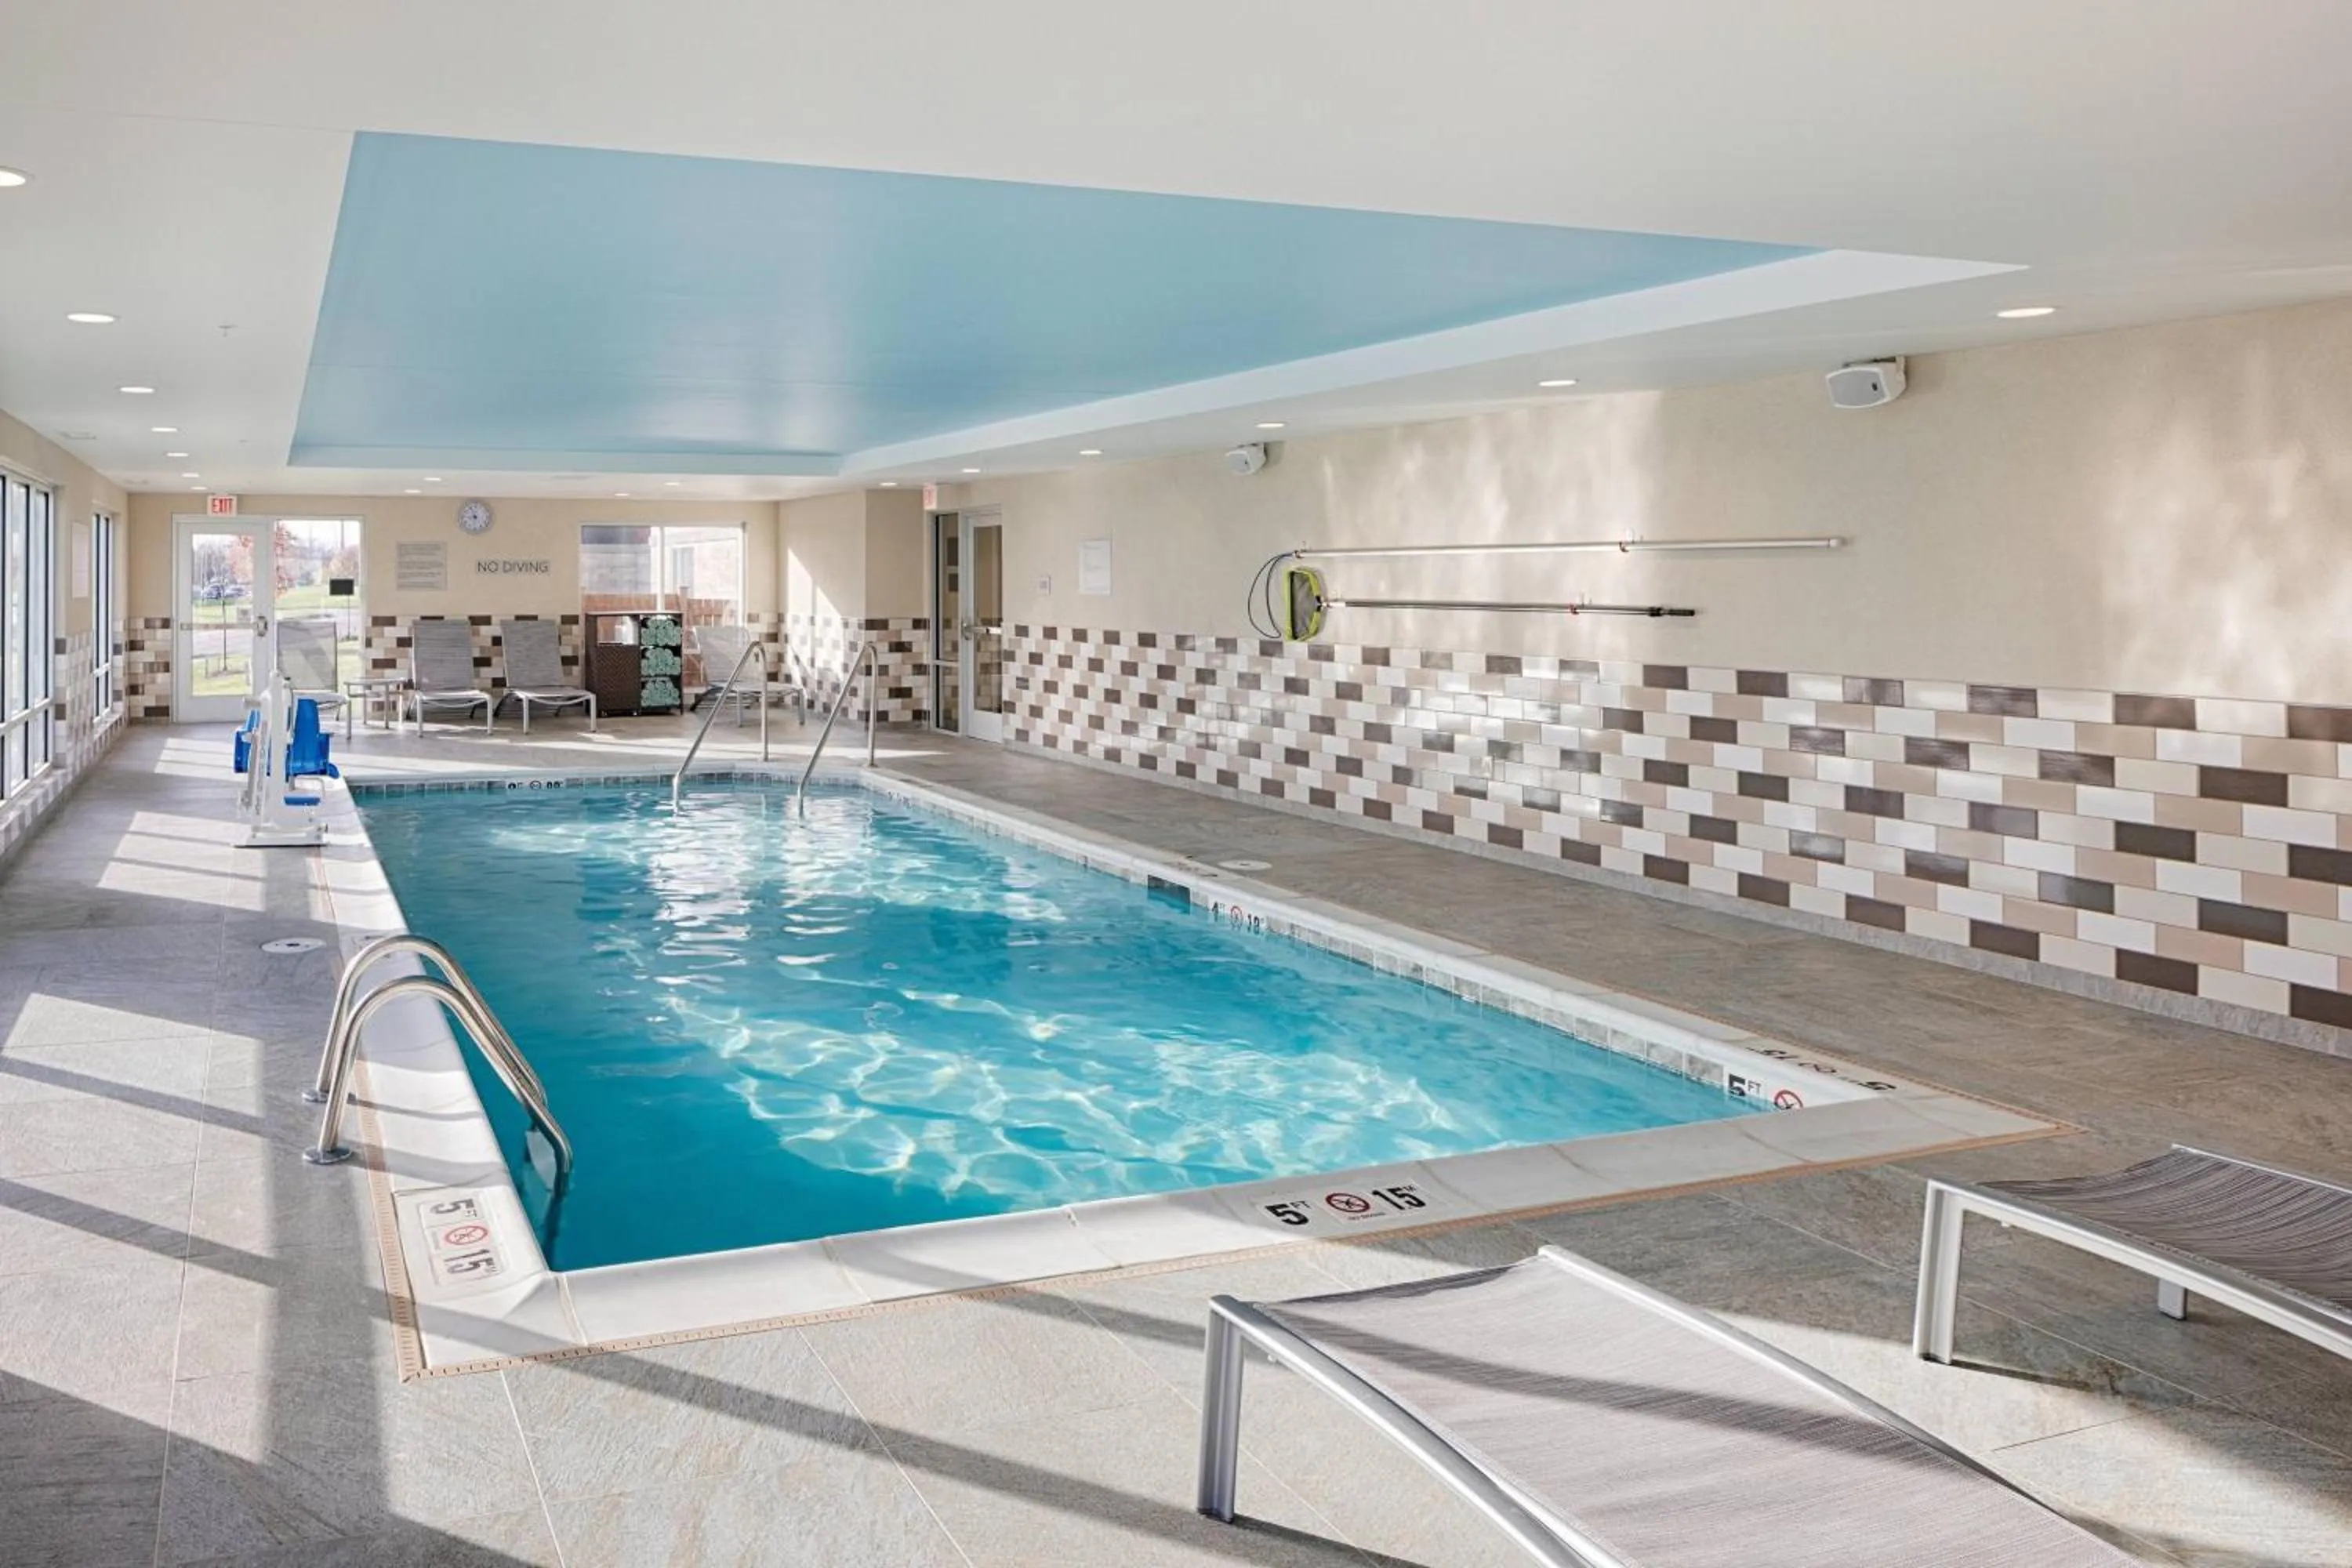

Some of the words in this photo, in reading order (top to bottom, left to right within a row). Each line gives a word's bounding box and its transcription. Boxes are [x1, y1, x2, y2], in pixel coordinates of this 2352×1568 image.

[212, 498, 233, 514] EXIT
[477, 560, 499, 573] NO
[503, 560, 549, 573] DIVING
[1729, 1073, 1745, 1097] 5
[1748, 1080, 1761, 1094] FT
[430, 1199, 474, 1214] 5
[1265, 1203, 1309, 1225] 5
